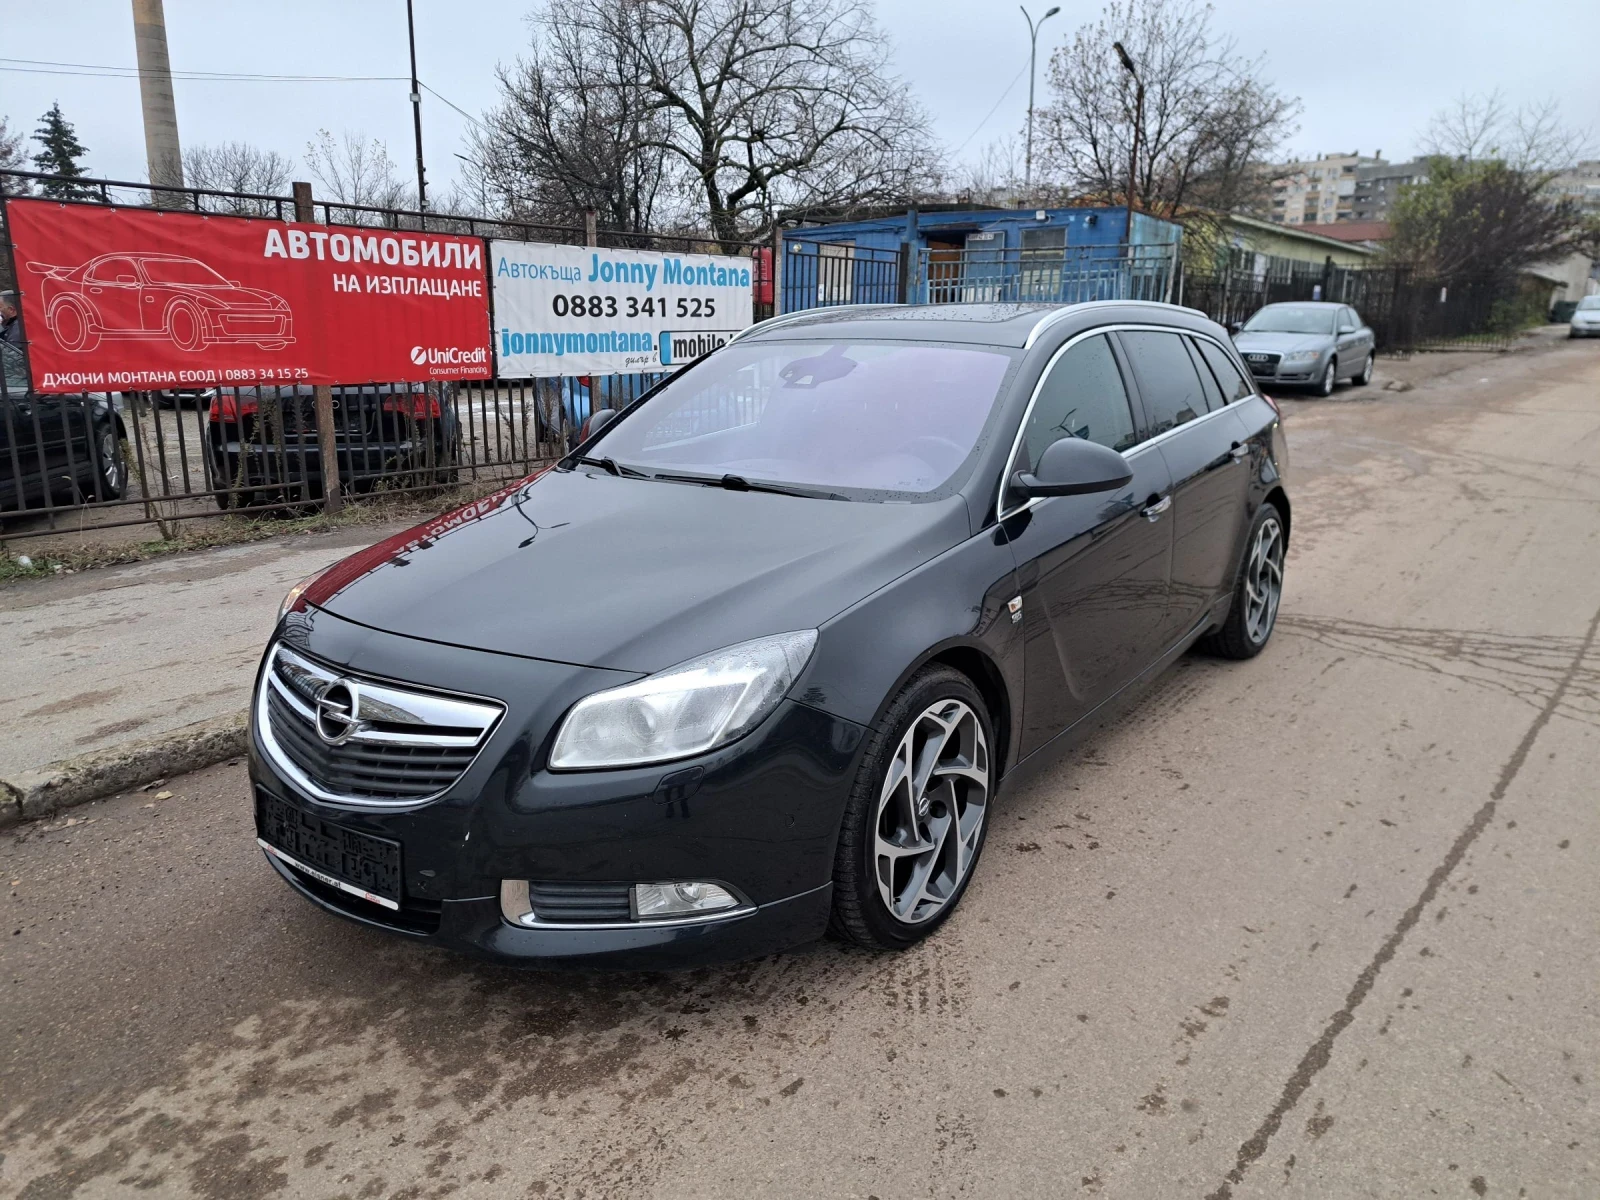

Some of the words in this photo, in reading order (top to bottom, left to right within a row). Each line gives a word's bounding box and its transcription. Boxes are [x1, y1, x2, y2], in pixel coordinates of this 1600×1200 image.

[264, 228, 482, 270] АВТОМОБИЛИ
[497, 256, 582, 285] Автокъща
[588, 253, 657, 292] Jonny
[663, 258, 750, 288] Montana
[333, 273, 361, 293] НА
[366, 275, 482, 300] ИЗПЛАЩАНЕ
[552, 294, 618, 318] 0883
[626, 296, 667, 318] 341
[676, 297, 716, 318] 525
[427, 346, 487, 364] UniCredit
[42, 372, 104, 389] ДЖОНИ
[107, 371, 177, 384] МОНТАНА
[179, 370, 217, 383] ЕООД
[225, 368, 256, 380] 0883
[259, 368, 275, 380] 34
[277, 368, 292, 379] 15
[294, 367, 309, 379] 25
[429, 366, 459, 375] Consumer
[460, 365, 488, 375] Financing
